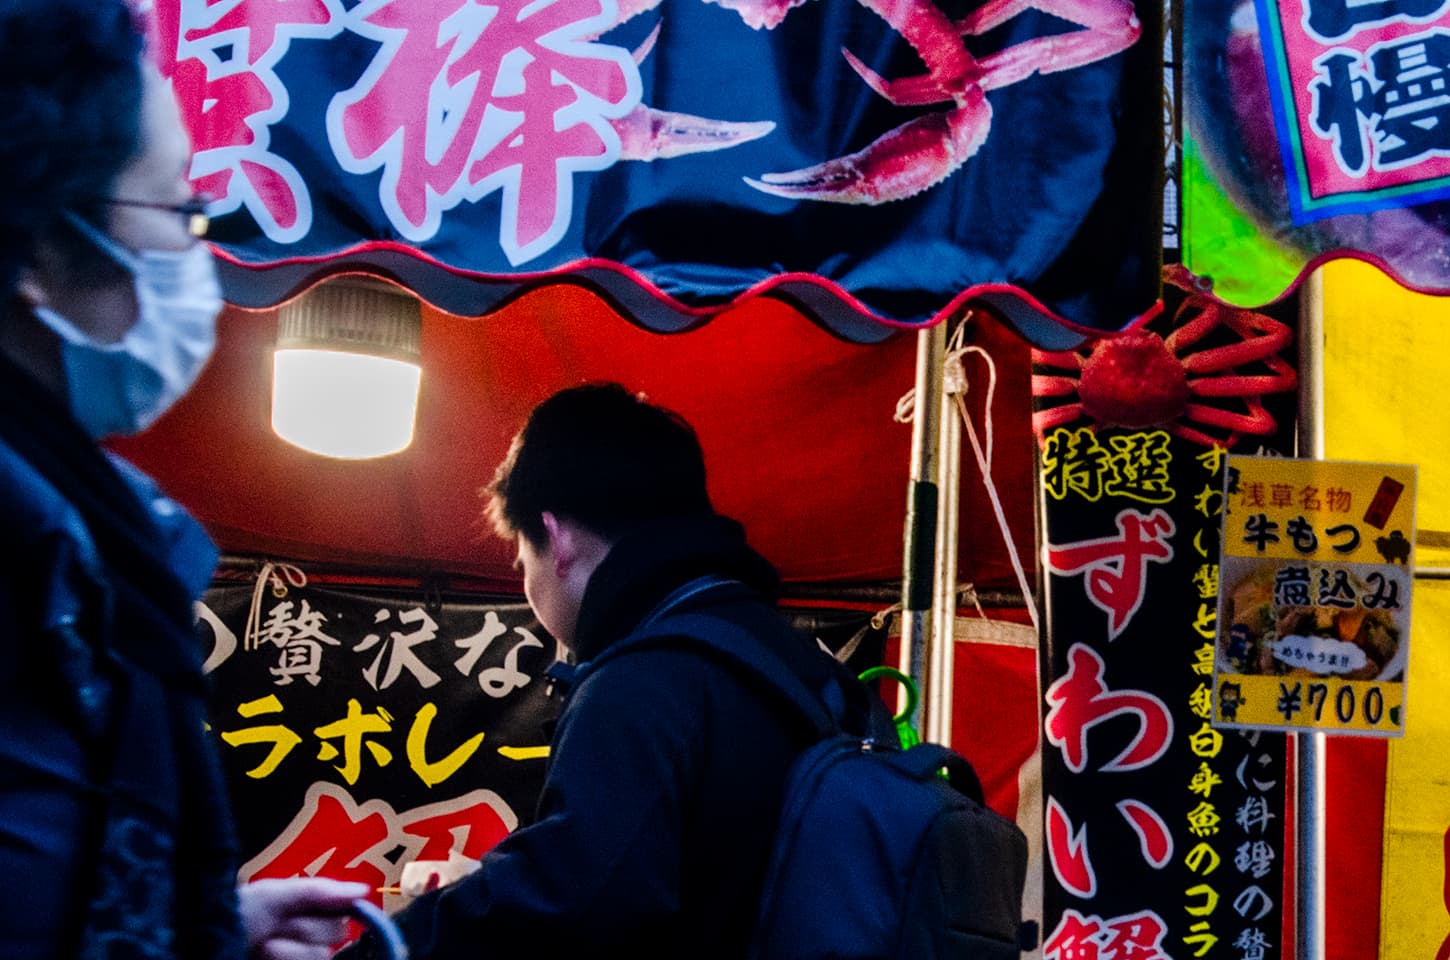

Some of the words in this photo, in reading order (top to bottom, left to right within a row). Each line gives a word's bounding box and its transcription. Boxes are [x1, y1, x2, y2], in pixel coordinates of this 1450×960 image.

[1042, 427, 1176, 503] 特選
[1240, 482, 1352, 512] 浅草名物
[1243, 512, 1361, 553] 牛もつ
[1274, 566, 1401, 610] 煮込み
[1277, 680, 1384, 725] ¥700
